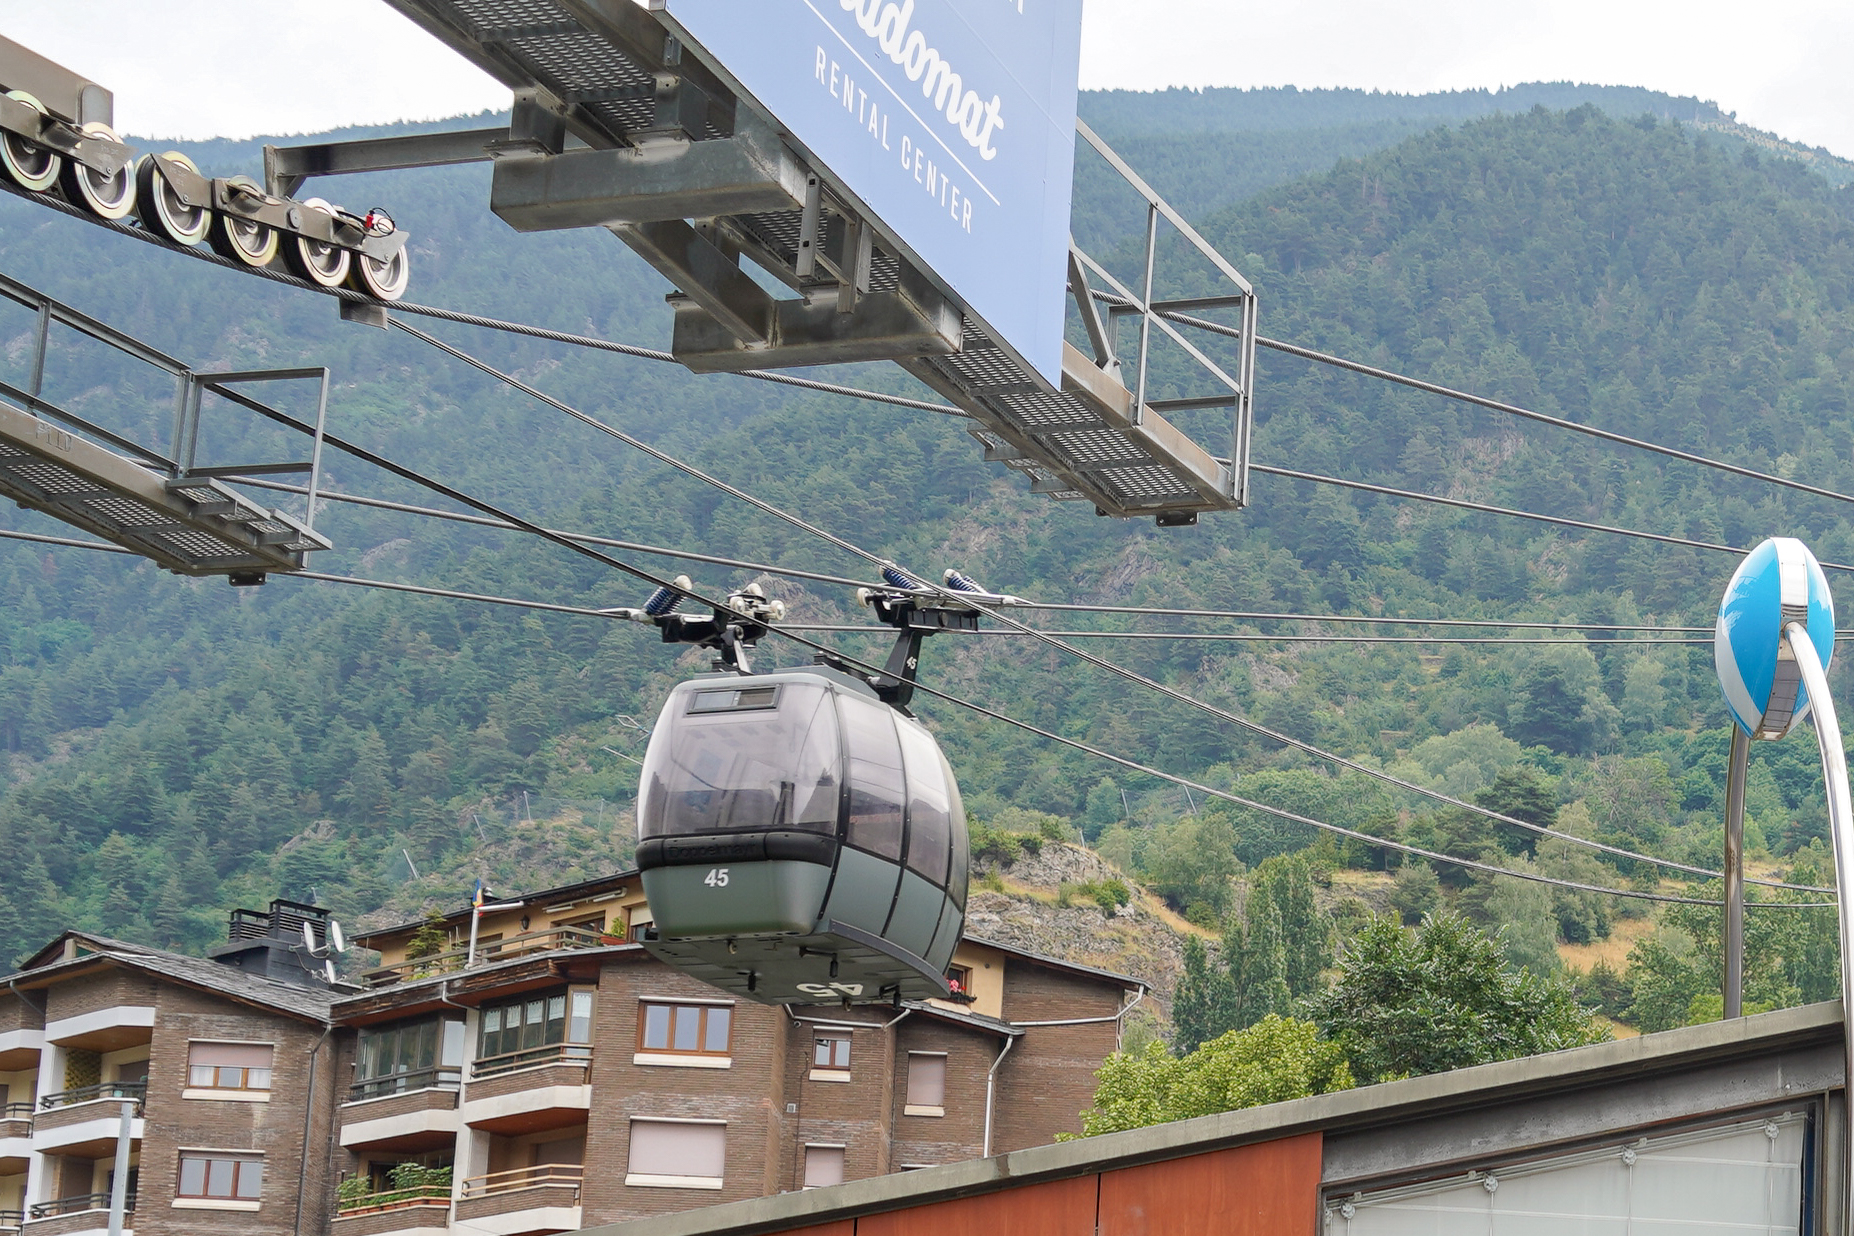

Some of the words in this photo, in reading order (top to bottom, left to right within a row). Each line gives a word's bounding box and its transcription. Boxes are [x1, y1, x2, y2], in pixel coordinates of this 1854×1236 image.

[840, 0, 1004, 161] udomat
[815, 45, 890, 151] RENTAL
[901, 135, 972, 234] CENTER
[906, 656, 917, 670] 45
[704, 868, 729, 888] 45
[796, 982, 864, 997] 45
